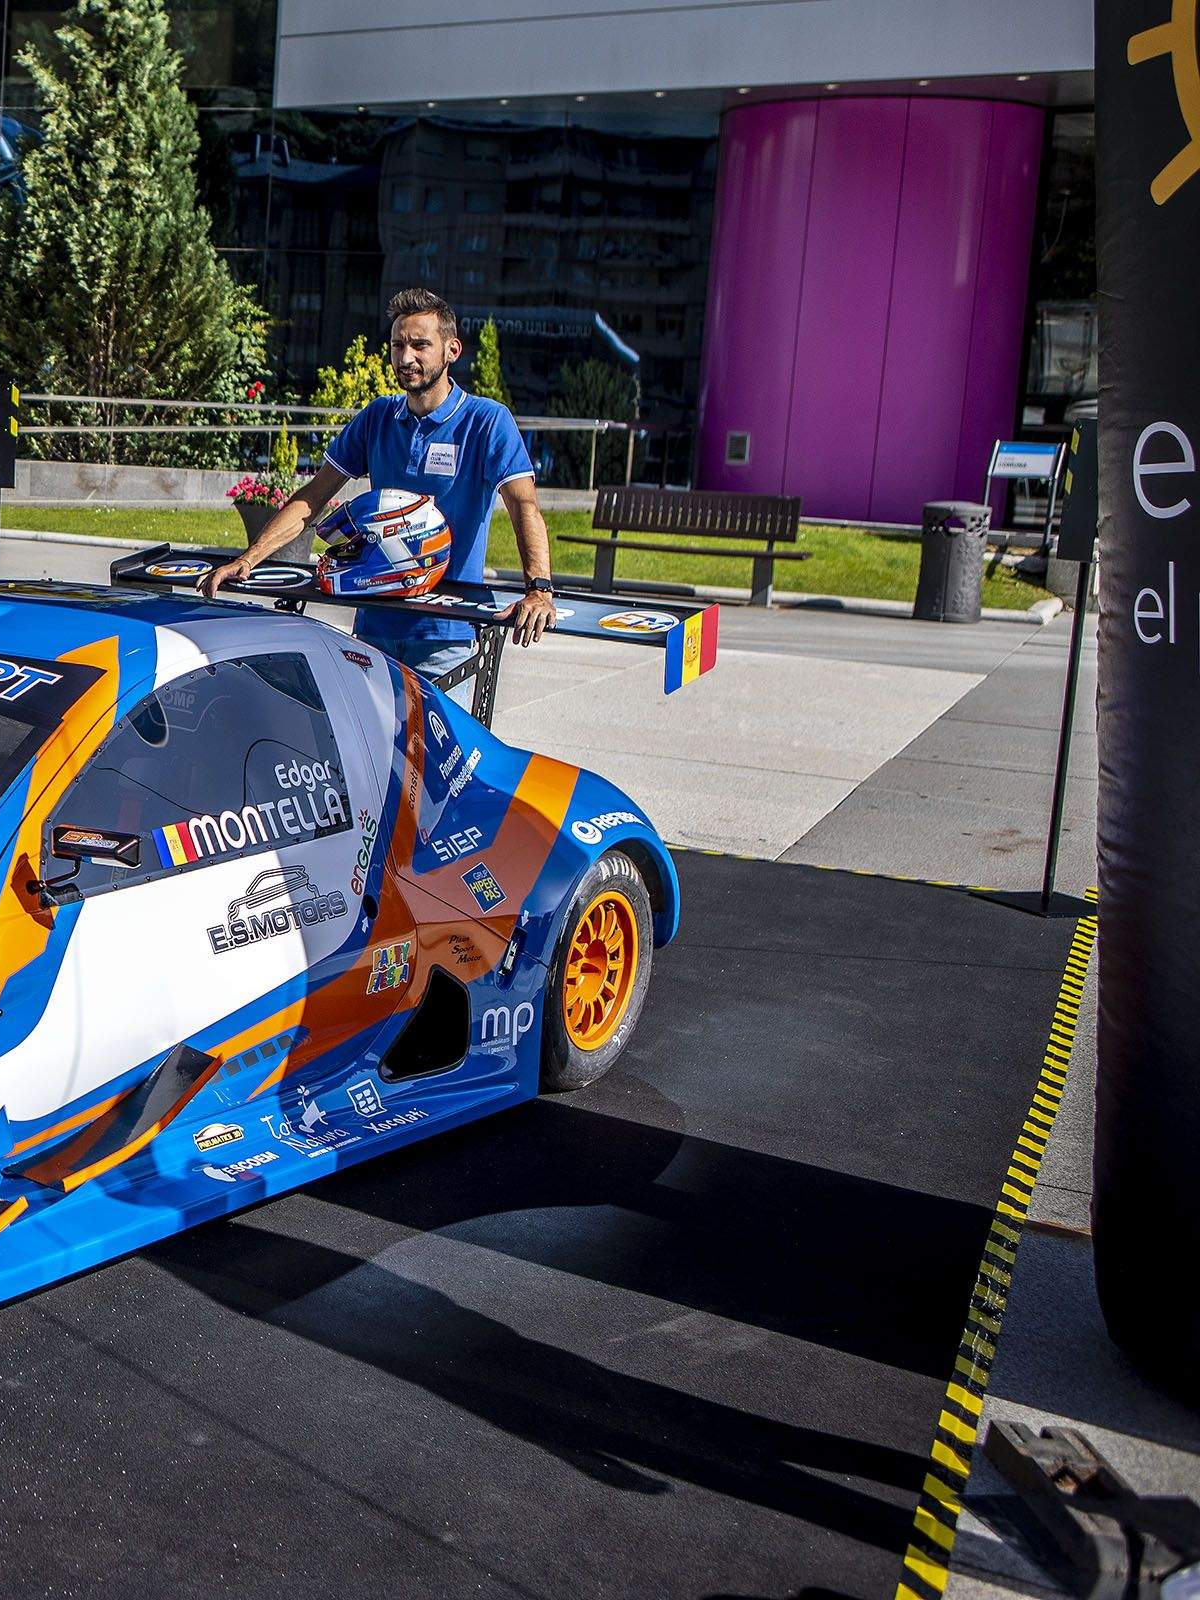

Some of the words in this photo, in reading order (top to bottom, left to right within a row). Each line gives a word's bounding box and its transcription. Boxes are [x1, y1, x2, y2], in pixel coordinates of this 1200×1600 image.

[273, 757, 332, 791] Edgar
[469, 877, 496, 894] HIPER
[483, 887, 501, 902] PAS
[451, 944, 475, 955] Sport
[456, 955, 482, 965] Motor
[482, 1002, 534, 1046] mp
[260, 1113, 296, 1140] Tot
[281, 1127, 350, 1155] Natura
